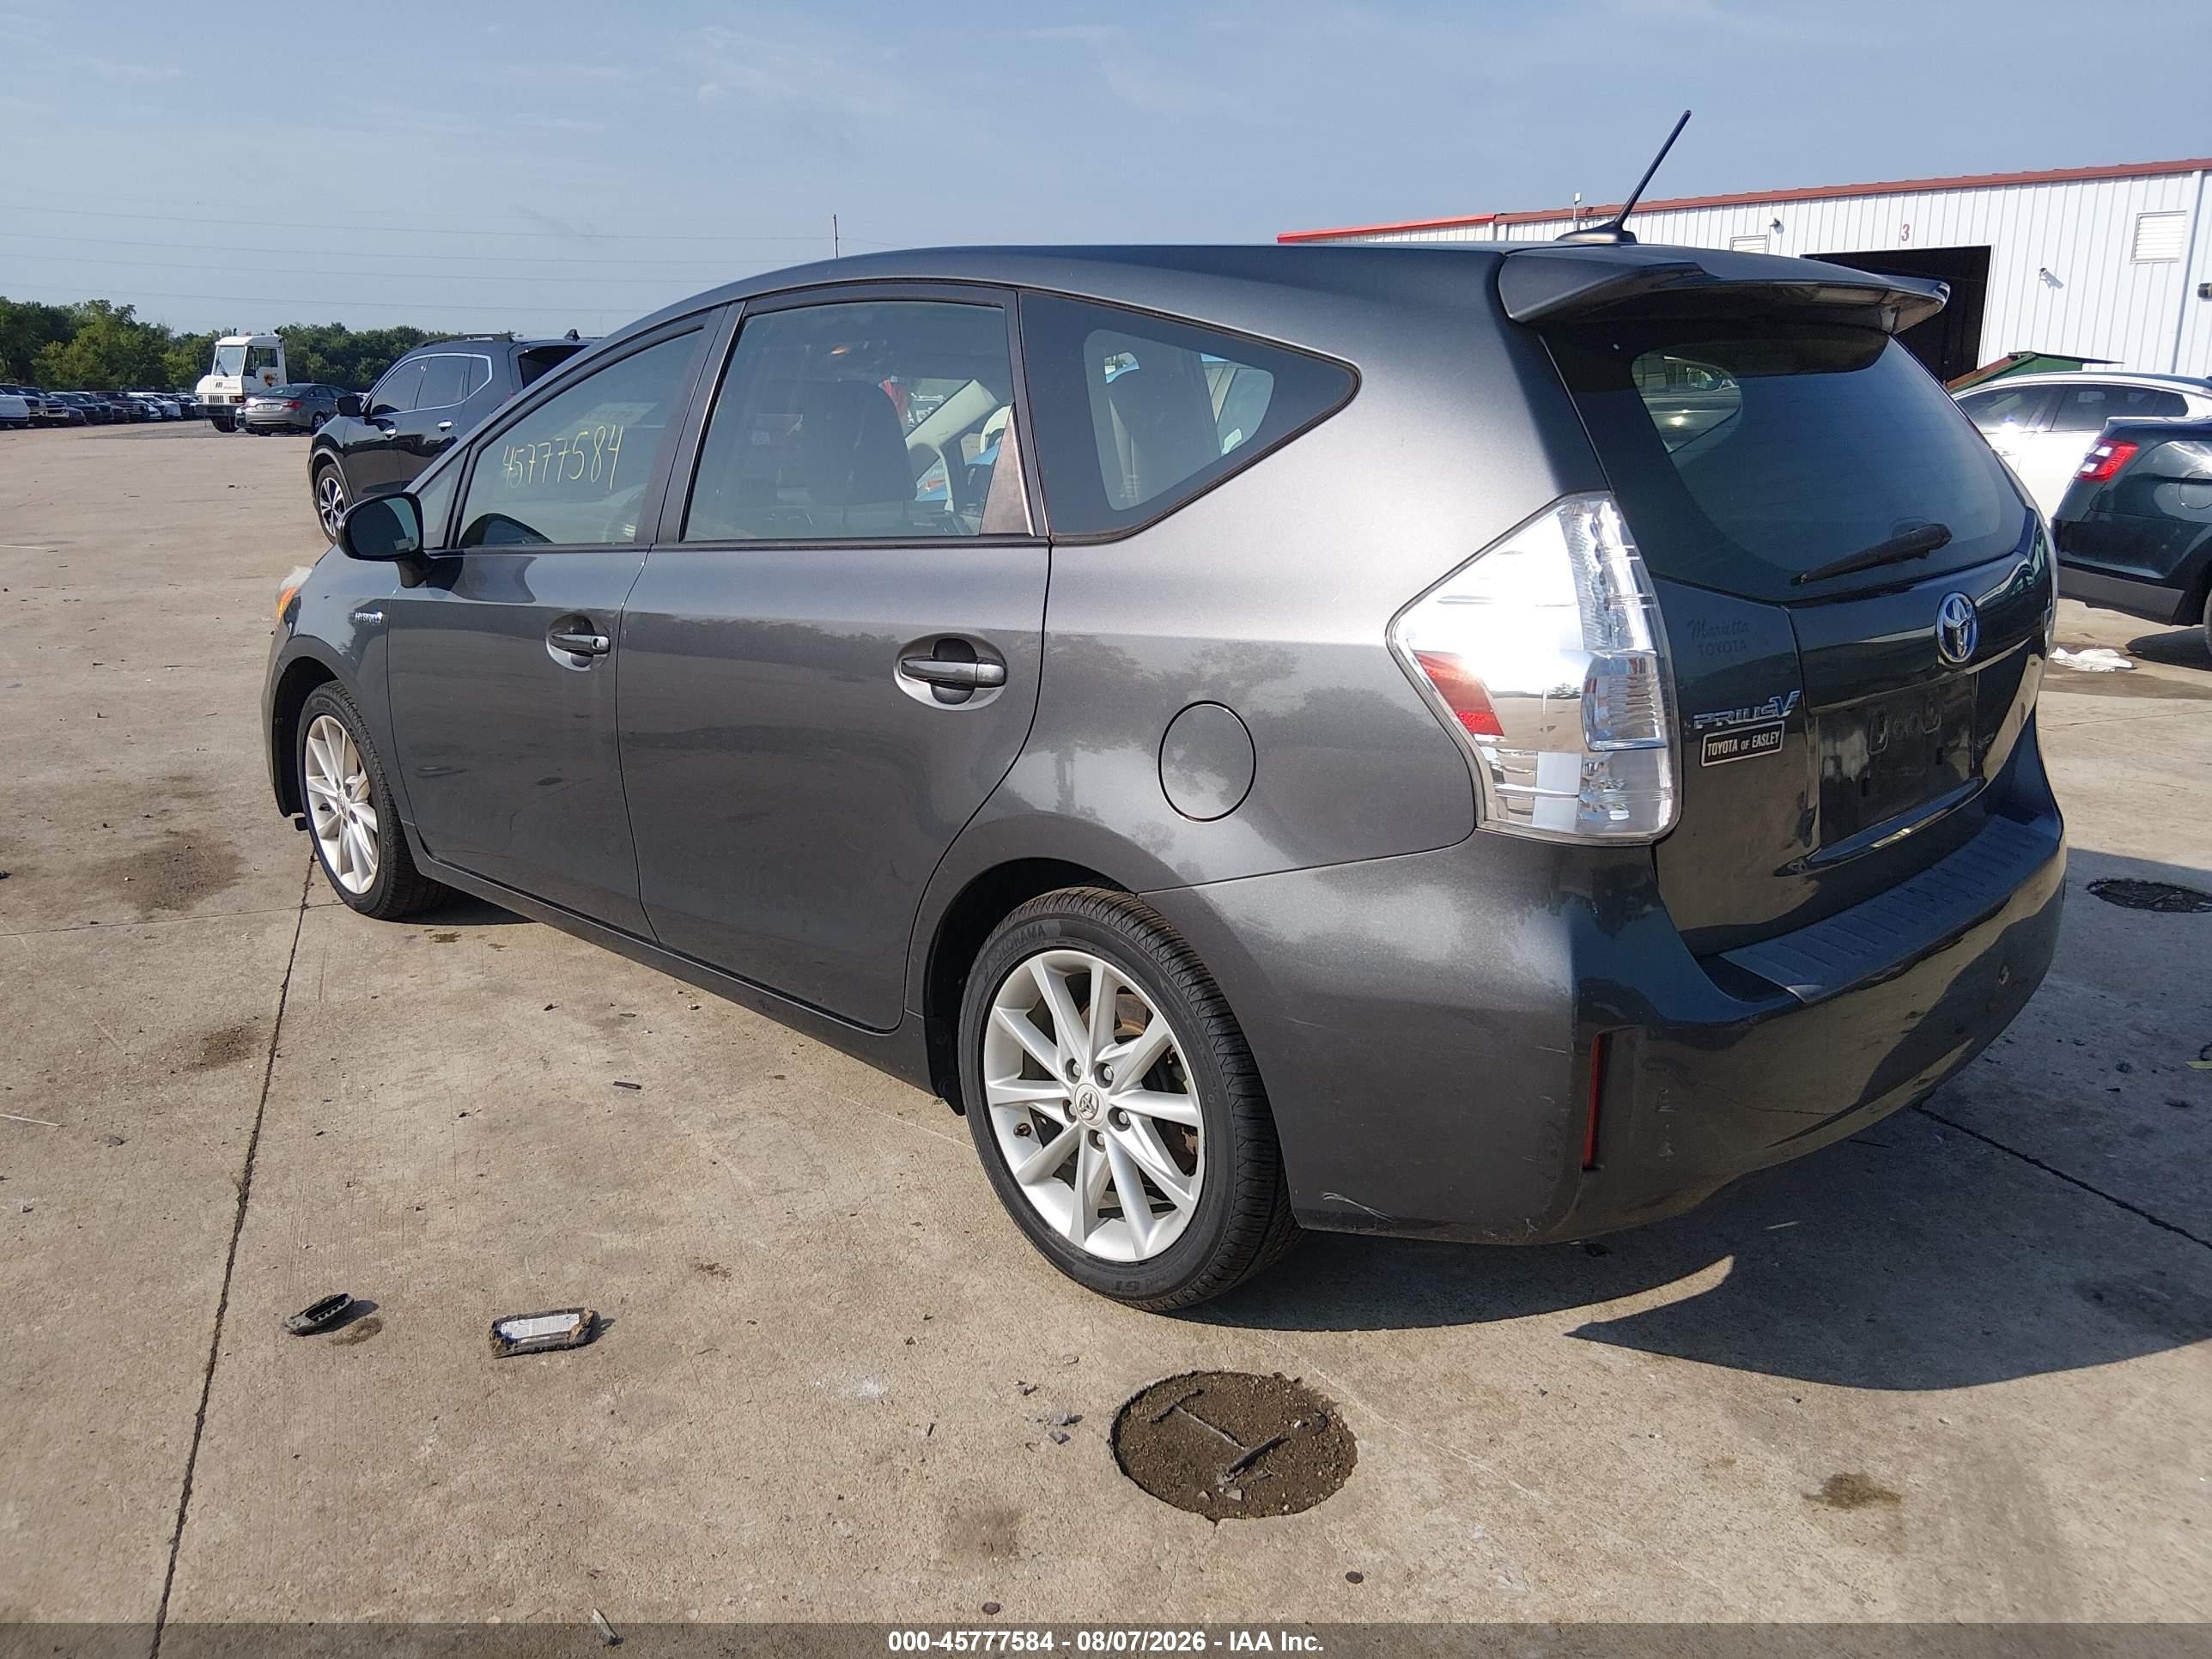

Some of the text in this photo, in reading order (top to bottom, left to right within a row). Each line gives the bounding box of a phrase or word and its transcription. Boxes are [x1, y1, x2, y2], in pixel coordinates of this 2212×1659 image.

[1901, 223, 1911, 241] 3
[502, 424, 624, 490] 45777584
[1697, 639, 1747, 658] TOYOTA
[1707, 730, 1780, 757] TOYOTA OF EASLEY
